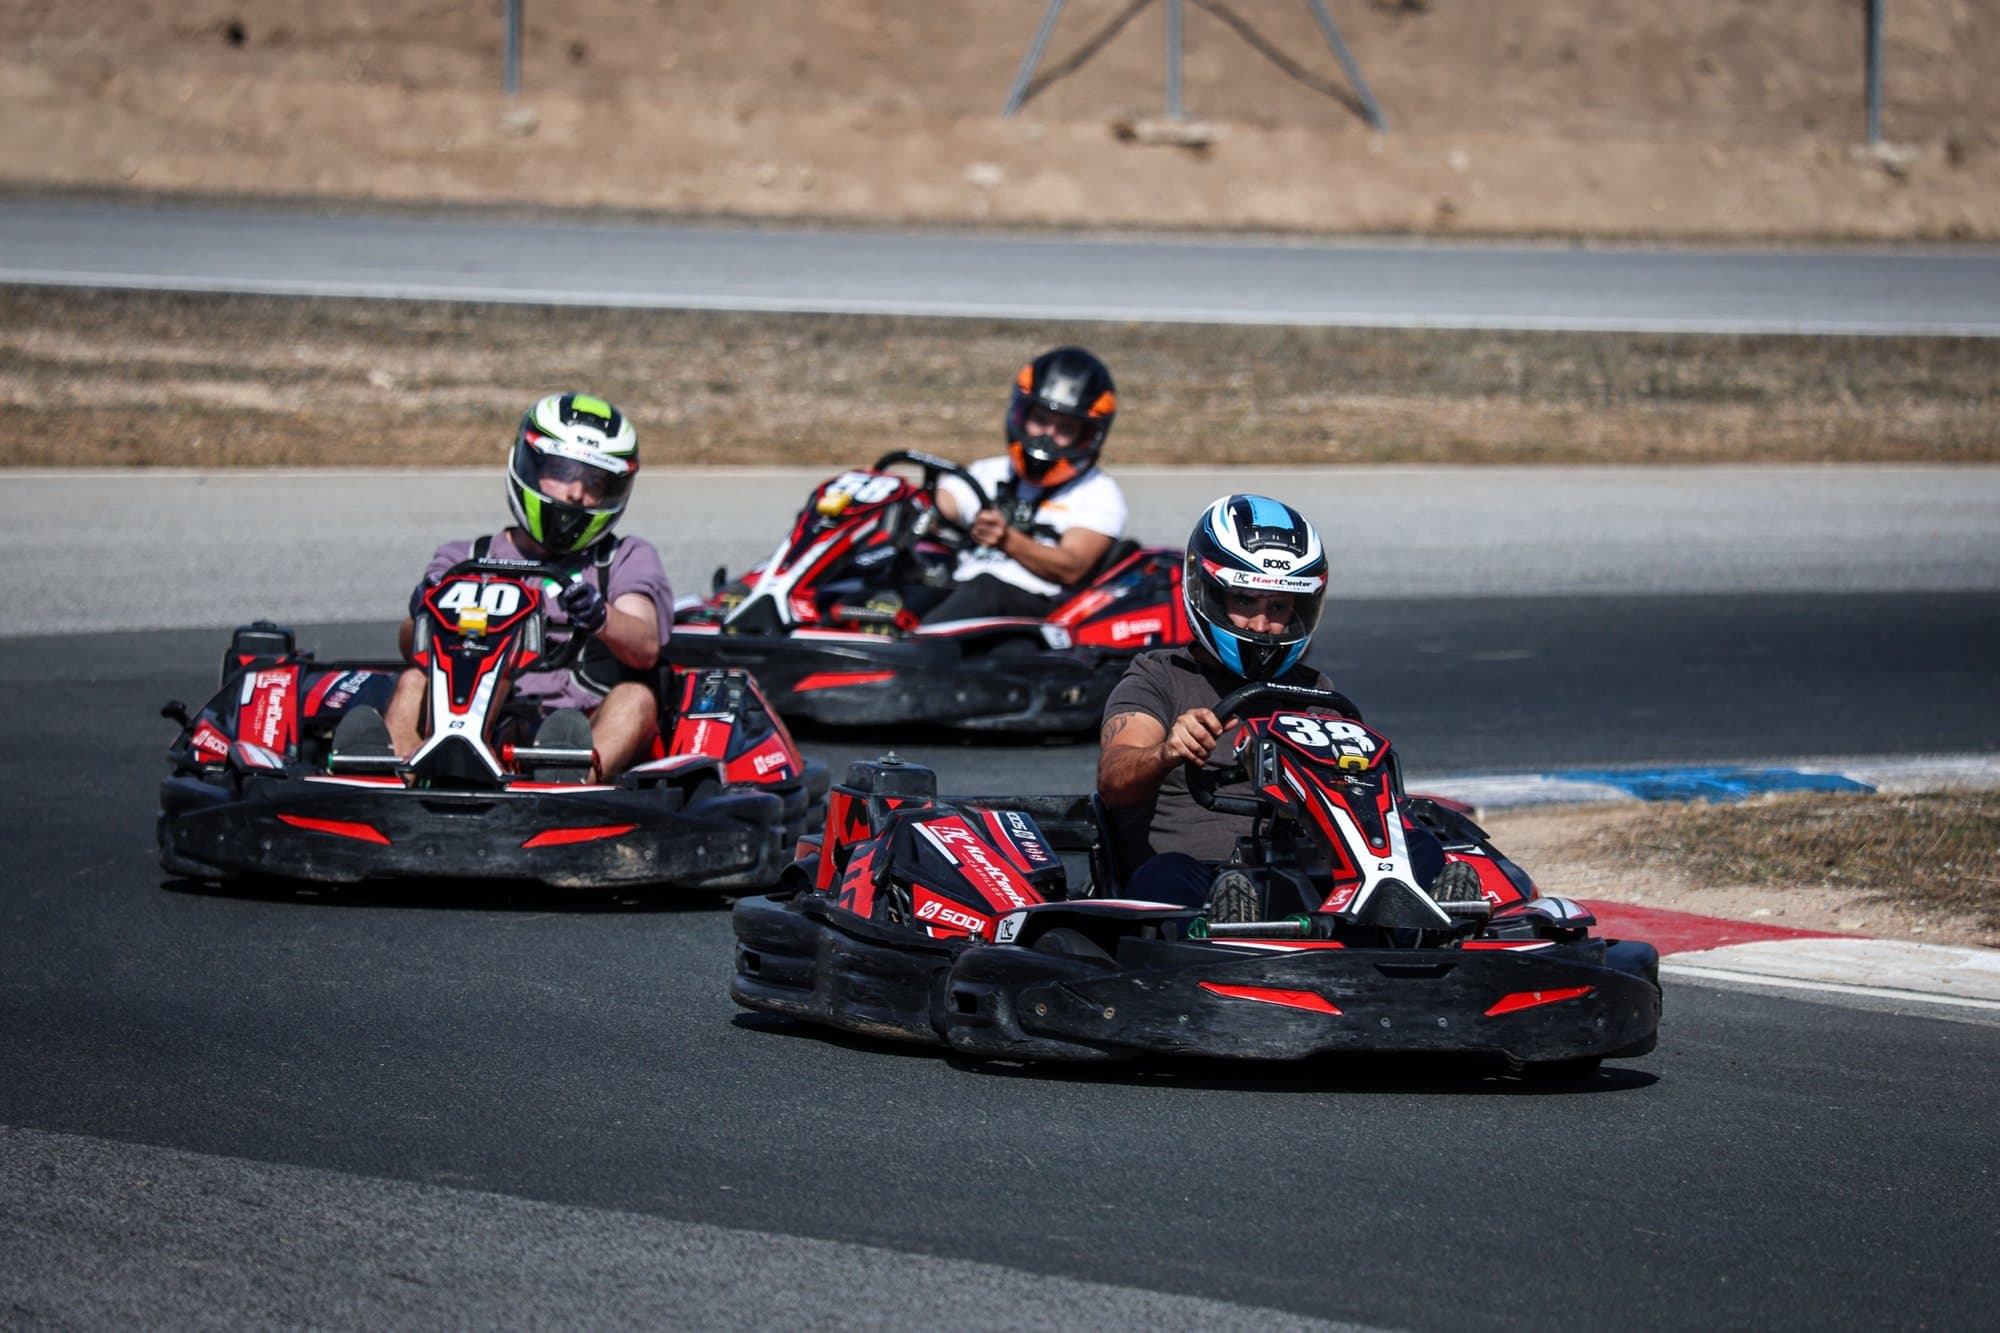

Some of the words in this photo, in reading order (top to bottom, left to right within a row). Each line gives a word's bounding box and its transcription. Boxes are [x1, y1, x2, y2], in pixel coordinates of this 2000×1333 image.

[1263, 558, 1292, 571] BOXS
[1252, 576, 1313, 588] KartCenter
[437, 582, 521, 616] 40
[1278, 715, 1377, 753] 38
[937, 909, 986, 932] SODI
